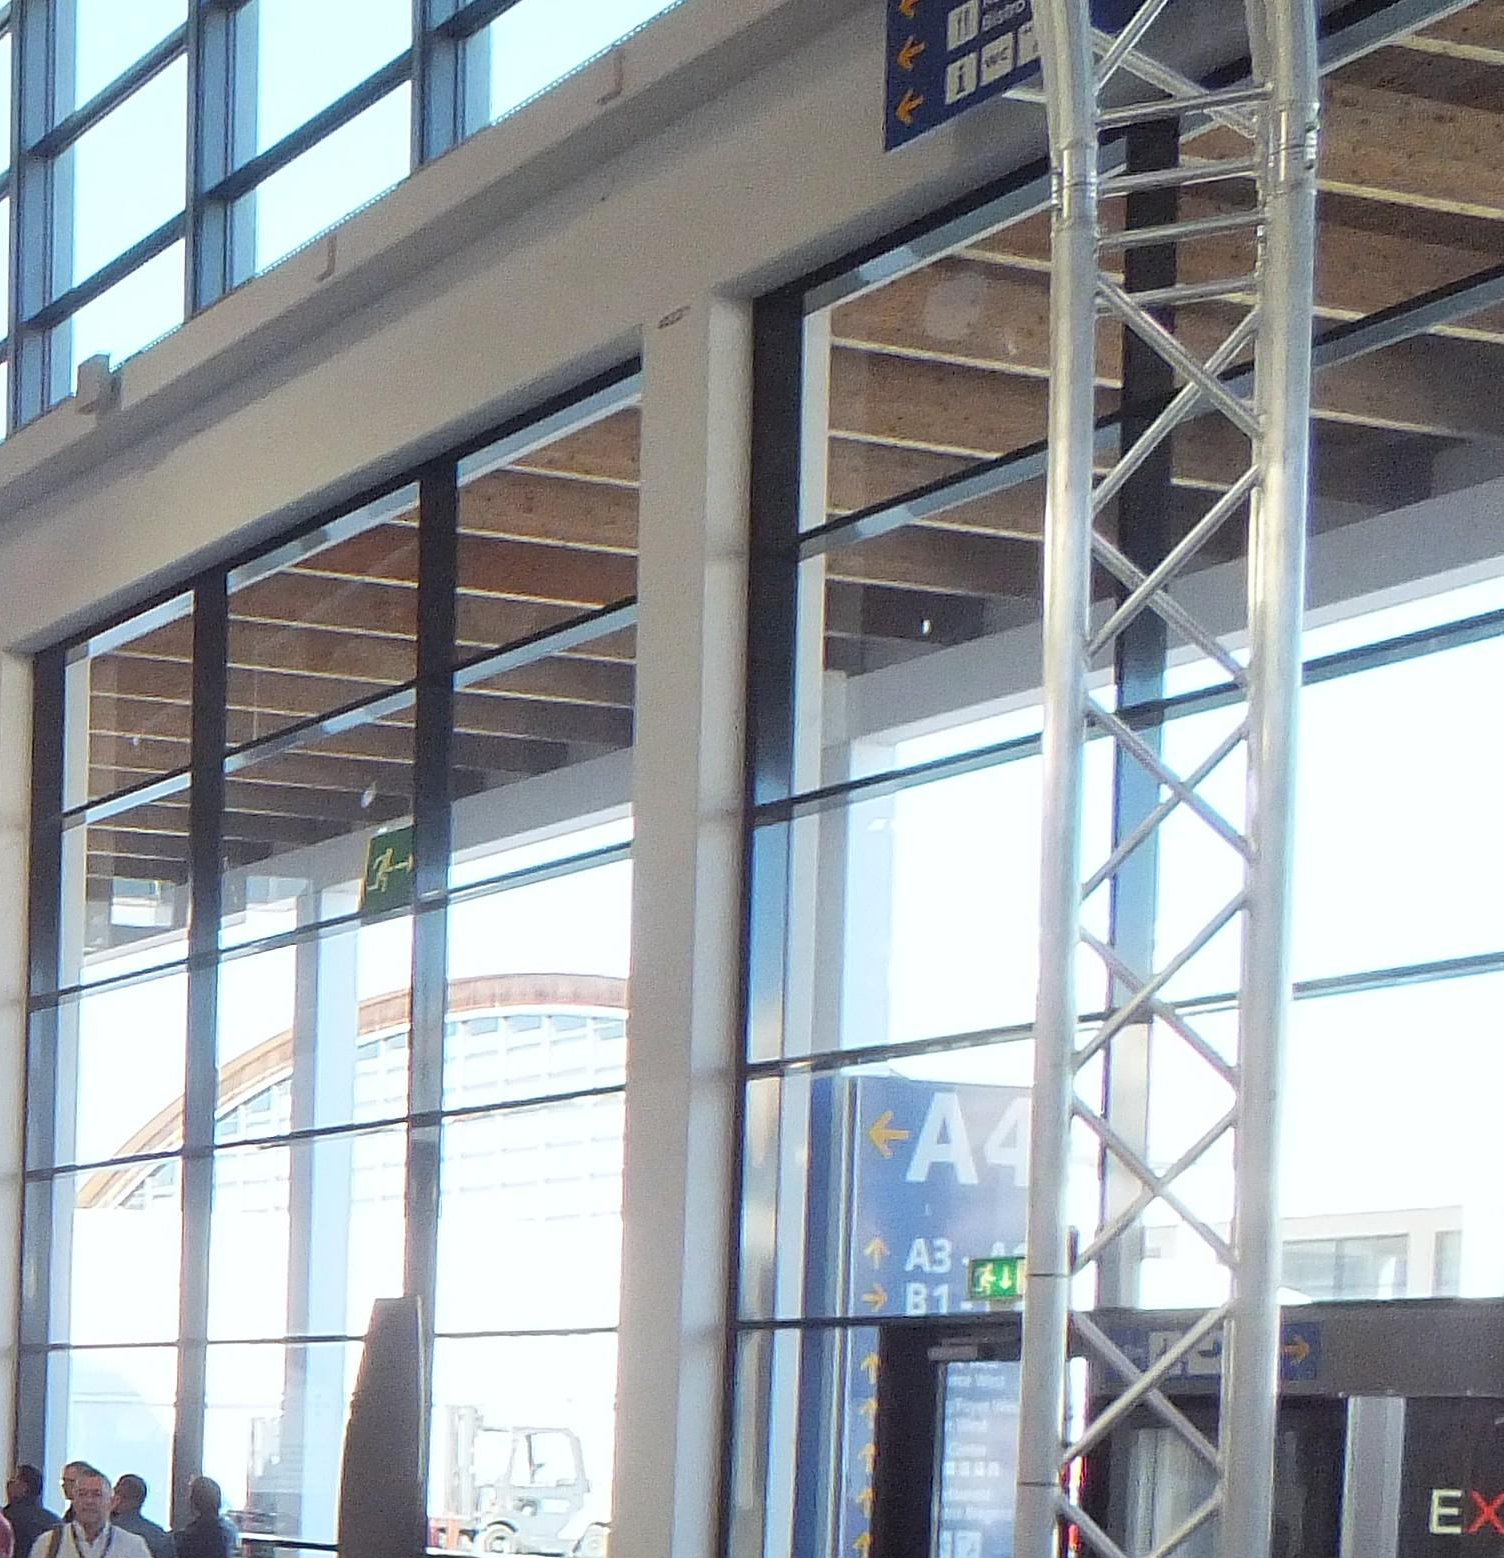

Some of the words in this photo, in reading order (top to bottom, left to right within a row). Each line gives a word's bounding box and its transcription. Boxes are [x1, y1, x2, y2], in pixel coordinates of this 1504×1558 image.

[905, 1238, 953, 1273] A3
[905, 1282, 950, 1315] B1
[1428, 1487, 1504, 1535] EX
